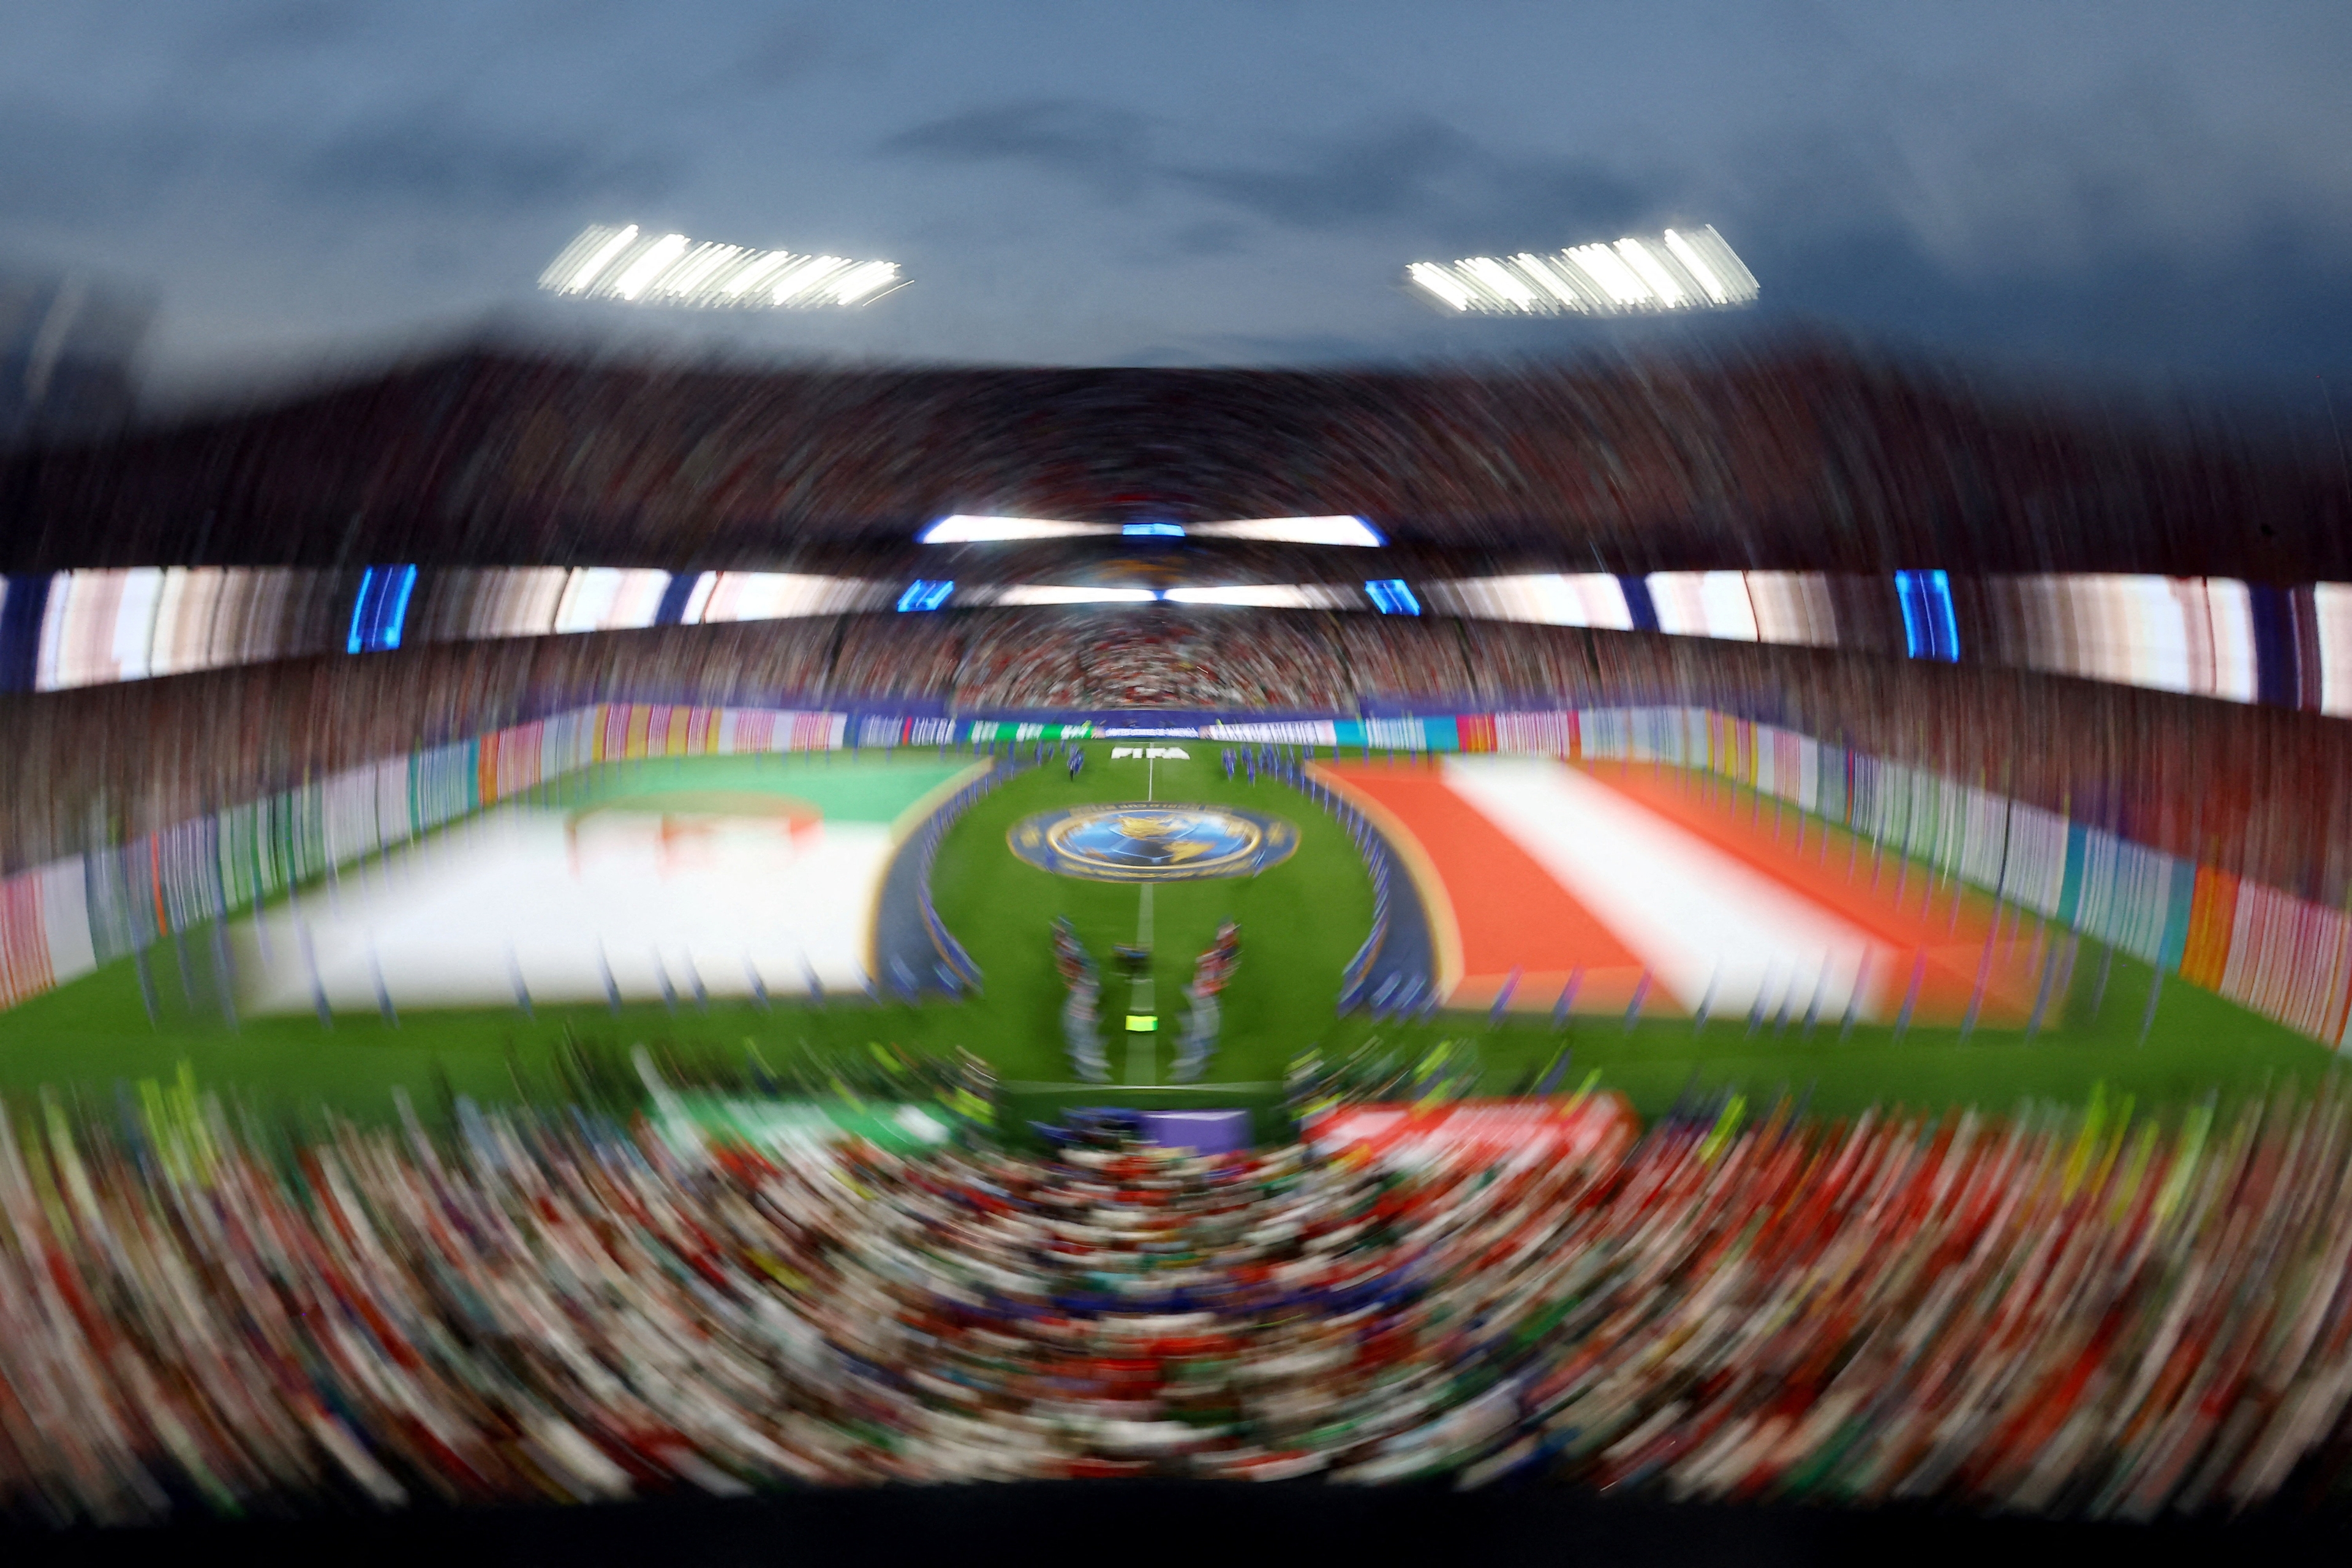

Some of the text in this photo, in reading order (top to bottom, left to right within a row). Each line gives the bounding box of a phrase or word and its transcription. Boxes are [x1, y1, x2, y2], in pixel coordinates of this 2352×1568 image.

[1213, 722, 1320, 745] BANK OF AMERICA
[1111, 747, 1190, 760] FIFA
